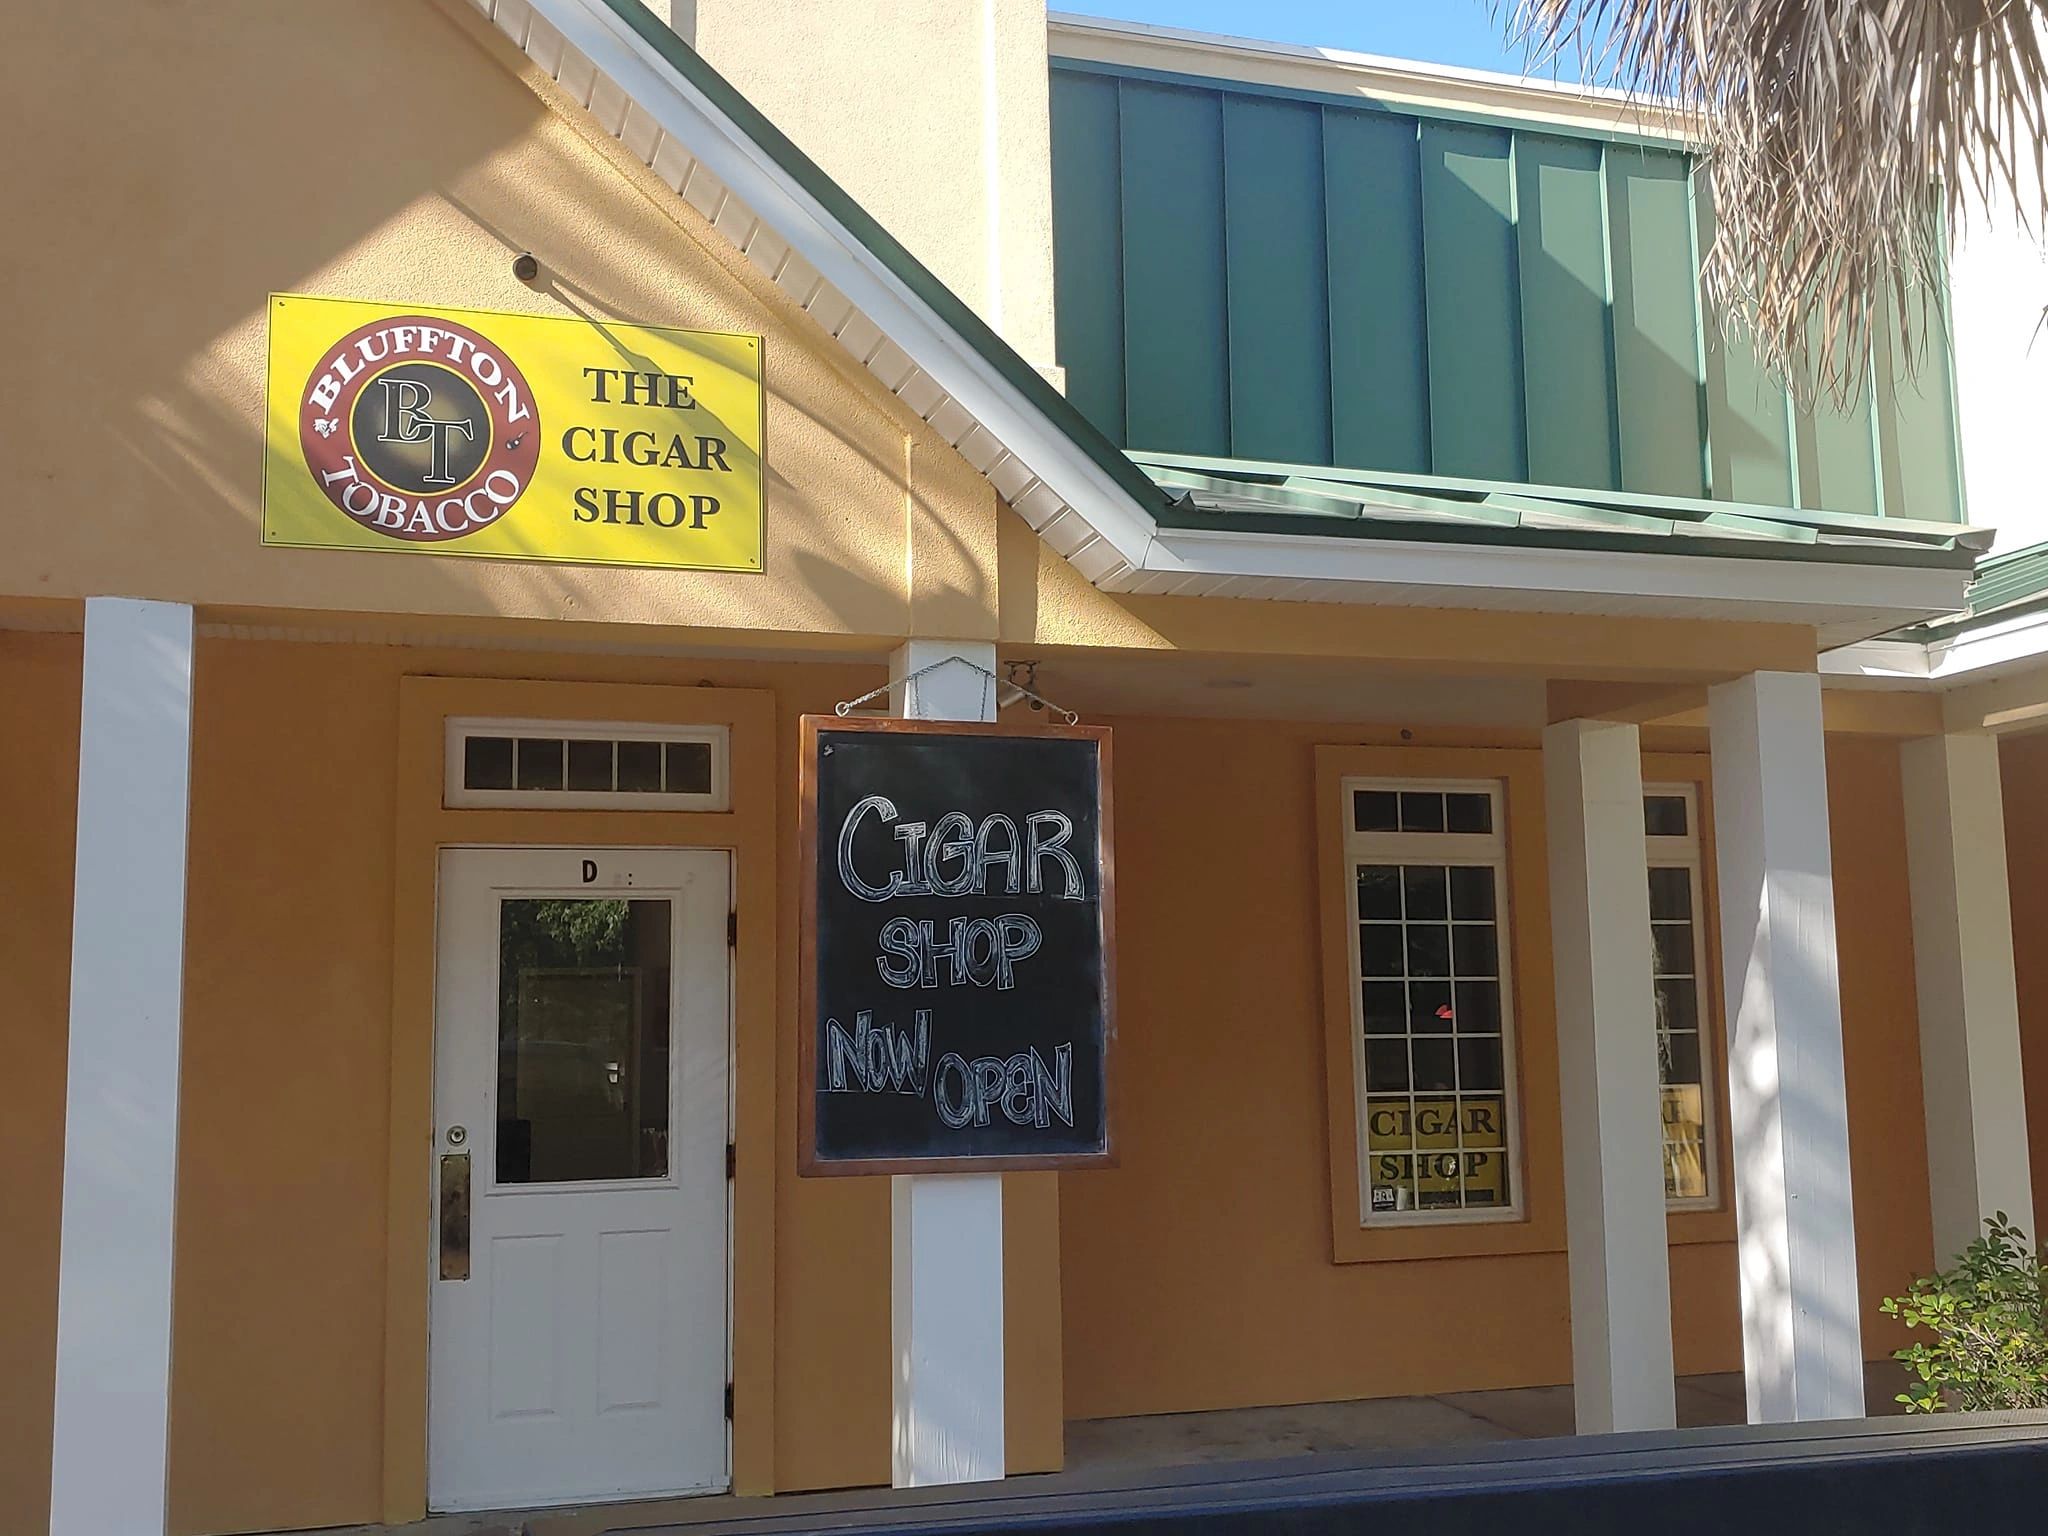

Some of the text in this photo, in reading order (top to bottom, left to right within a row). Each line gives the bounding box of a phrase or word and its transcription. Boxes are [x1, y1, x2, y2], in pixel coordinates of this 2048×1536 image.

[308, 325, 531, 424] BLUFFTON
[583, 367, 696, 410] THE
[562, 426, 732, 472] CIGAR
[321, 456, 520, 534] TOBACCO
[574, 487, 721, 530] SHOP
[837, 794, 1086, 903] CIGAR
[582, 860, 598, 883] D
[876, 913, 1043, 990] SHOP
[1370, 1107, 1496, 1136] CIGAR
[1380, 1152, 1489, 1181] SHOP
